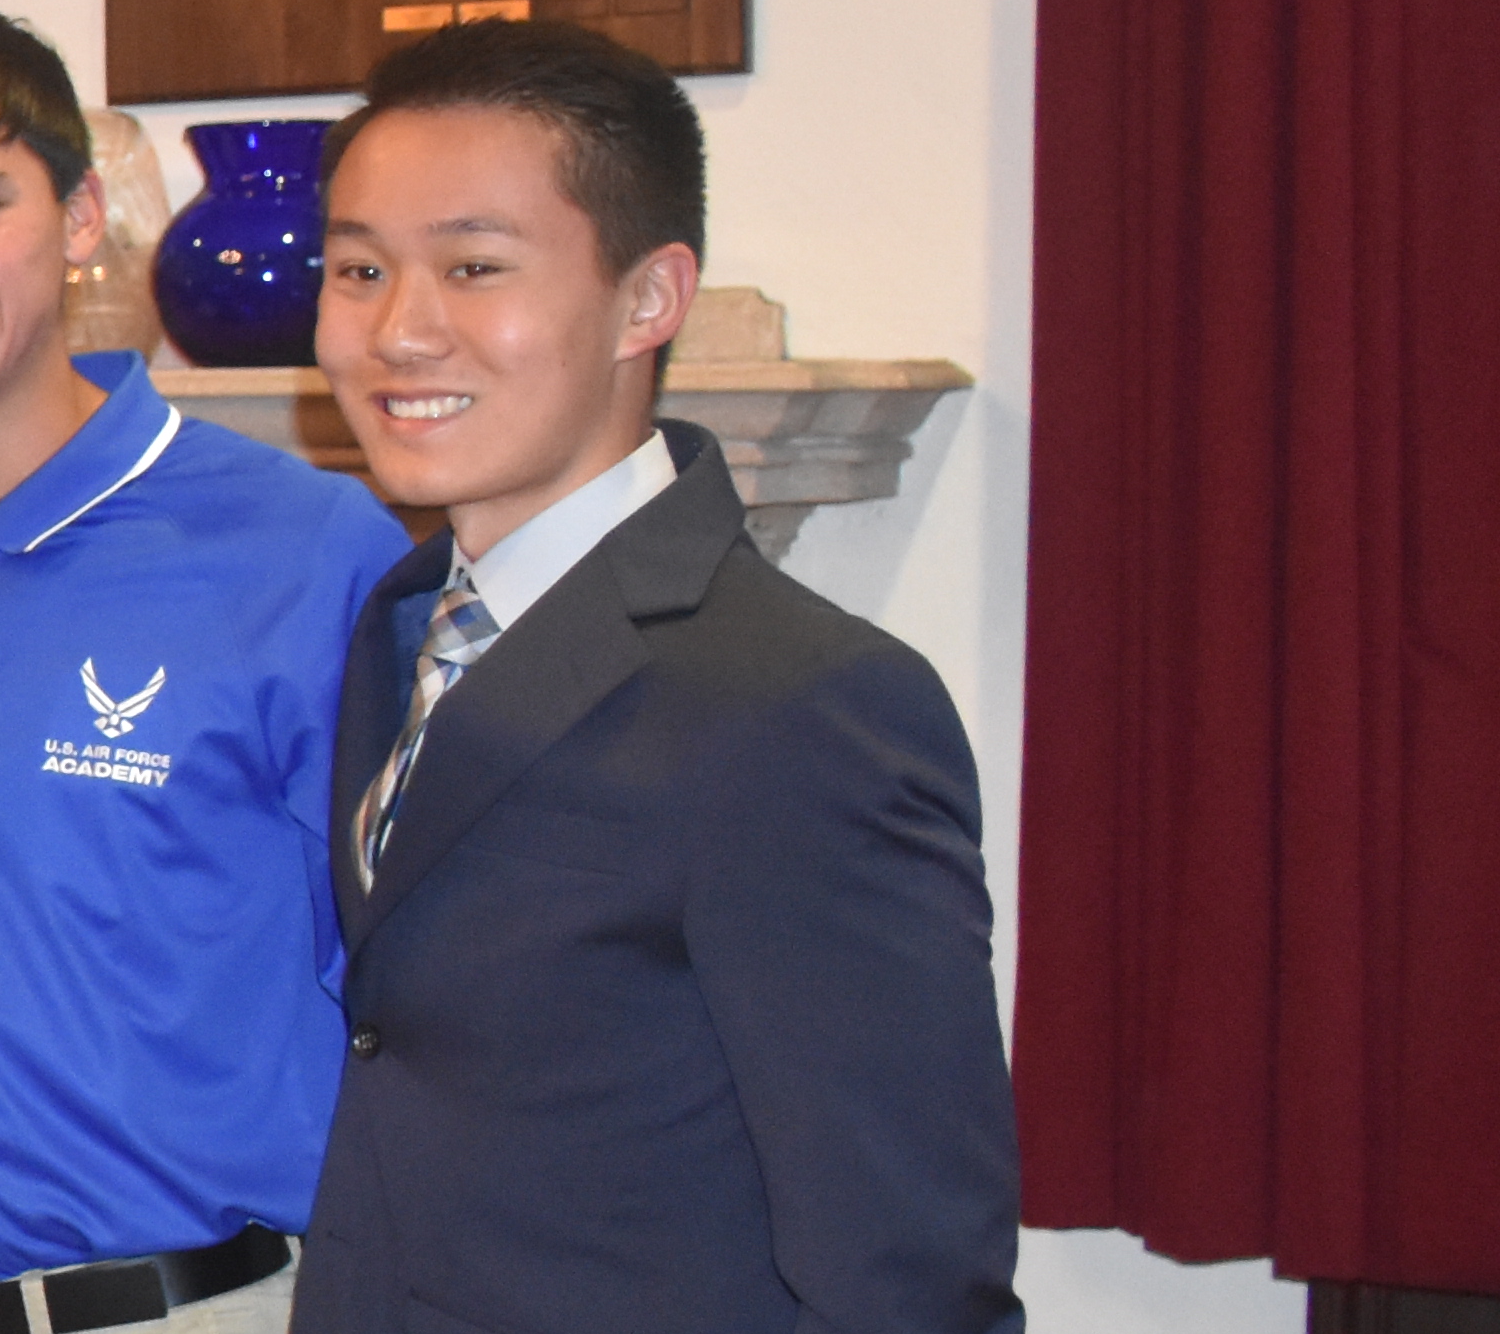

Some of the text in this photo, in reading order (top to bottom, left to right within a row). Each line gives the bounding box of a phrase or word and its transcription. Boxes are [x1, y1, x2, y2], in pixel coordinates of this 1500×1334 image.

[44, 738, 171, 769] U.S. AIR FORCE
[41, 754, 170, 788] ACADEMY
